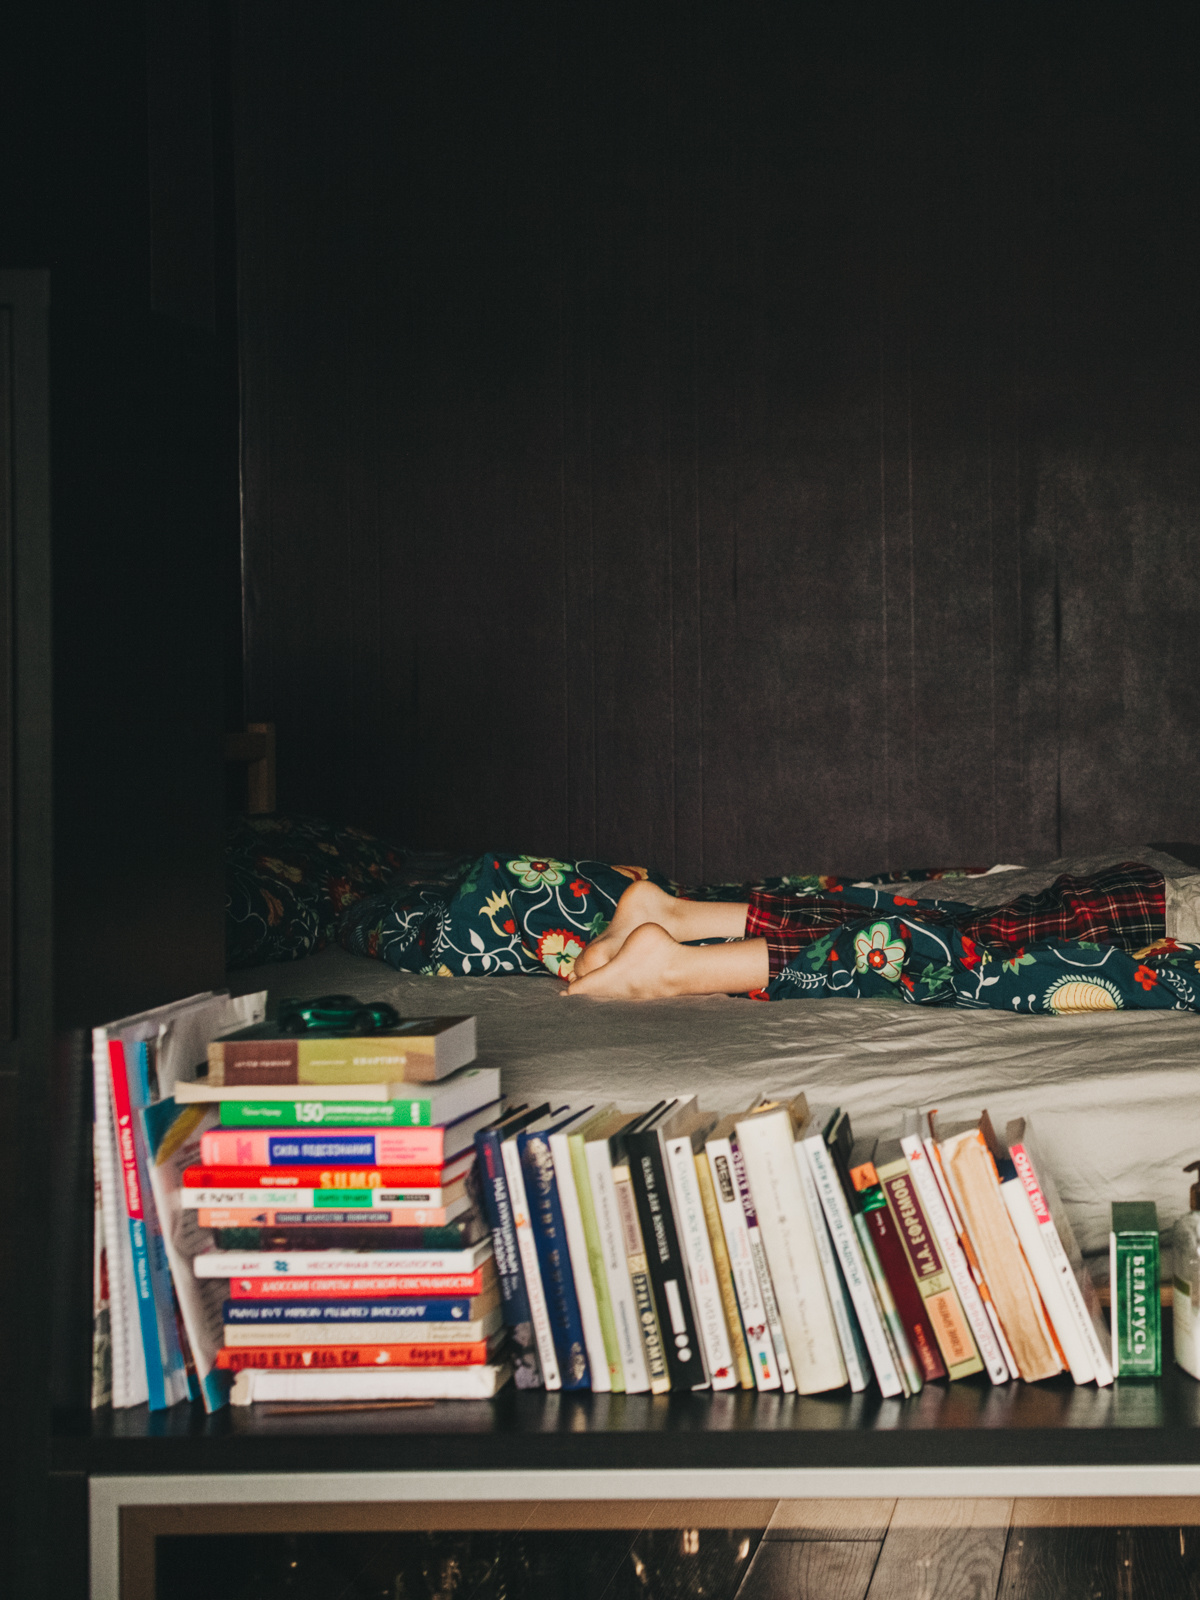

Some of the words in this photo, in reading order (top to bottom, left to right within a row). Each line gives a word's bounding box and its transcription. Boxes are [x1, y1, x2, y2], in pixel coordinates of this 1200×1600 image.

[294, 1102, 325, 1123] 150
[272, 1144, 299, 1157] СИЛА
[1014, 1151, 1038, 1191] БУРБО
[826, 1196, 844, 1231] ДОЛГОВ
[890, 1178, 926, 1245] ЕФРЕМОВ
[1030, 1191, 1048, 1217] ЛИЗ
[916, 1243, 937, 1274] И.А.
[634, 1275, 650, 1309] ЭРИХ
[1133, 1255, 1147, 1355] БЕЛАРУСЬ
[641, 1310, 664, 1375] ФРОММ
